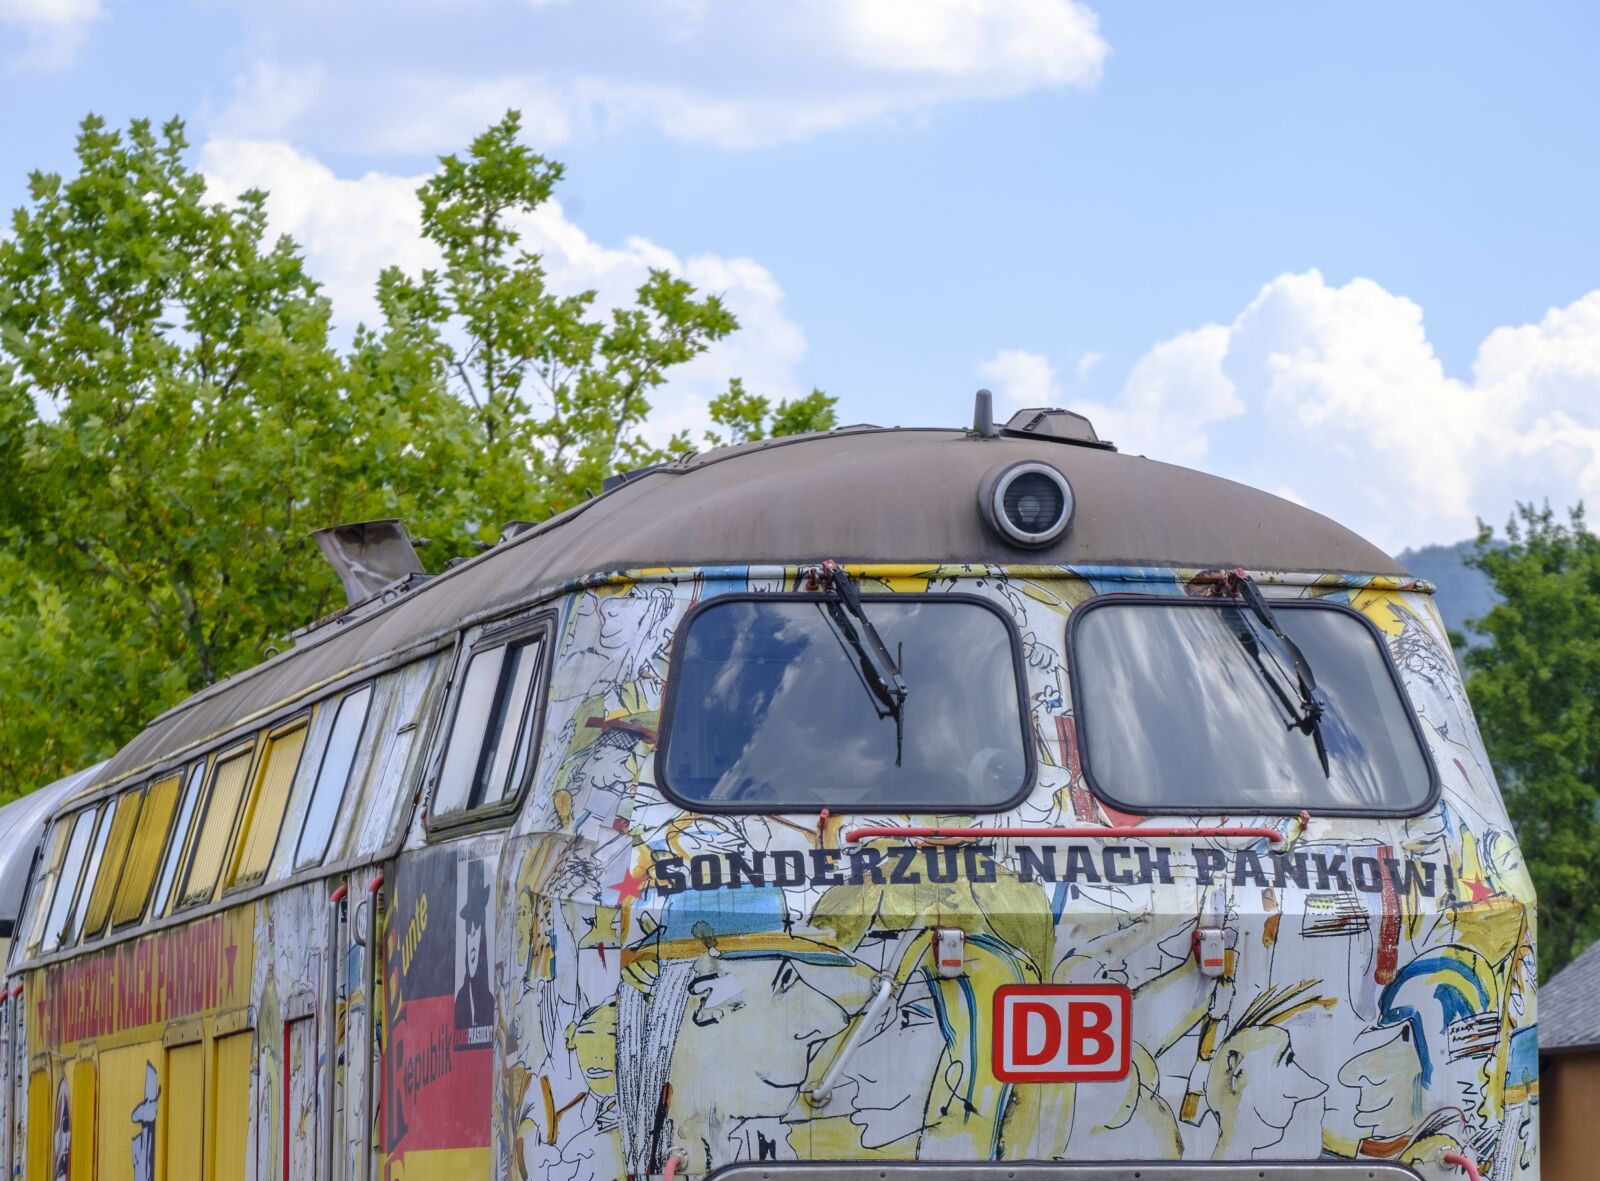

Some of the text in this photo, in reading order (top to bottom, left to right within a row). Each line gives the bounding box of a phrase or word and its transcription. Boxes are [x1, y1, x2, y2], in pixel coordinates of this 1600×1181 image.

[655, 844, 1455, 900] SONDERZUG NACH PANKOW!
[117, 938, 153, 1031] NACH
[384, 888, 428, 1025] Bunte
[1012, 1002, 1115, 1067] DB
[388, 1010, 452, 1154] Republik
